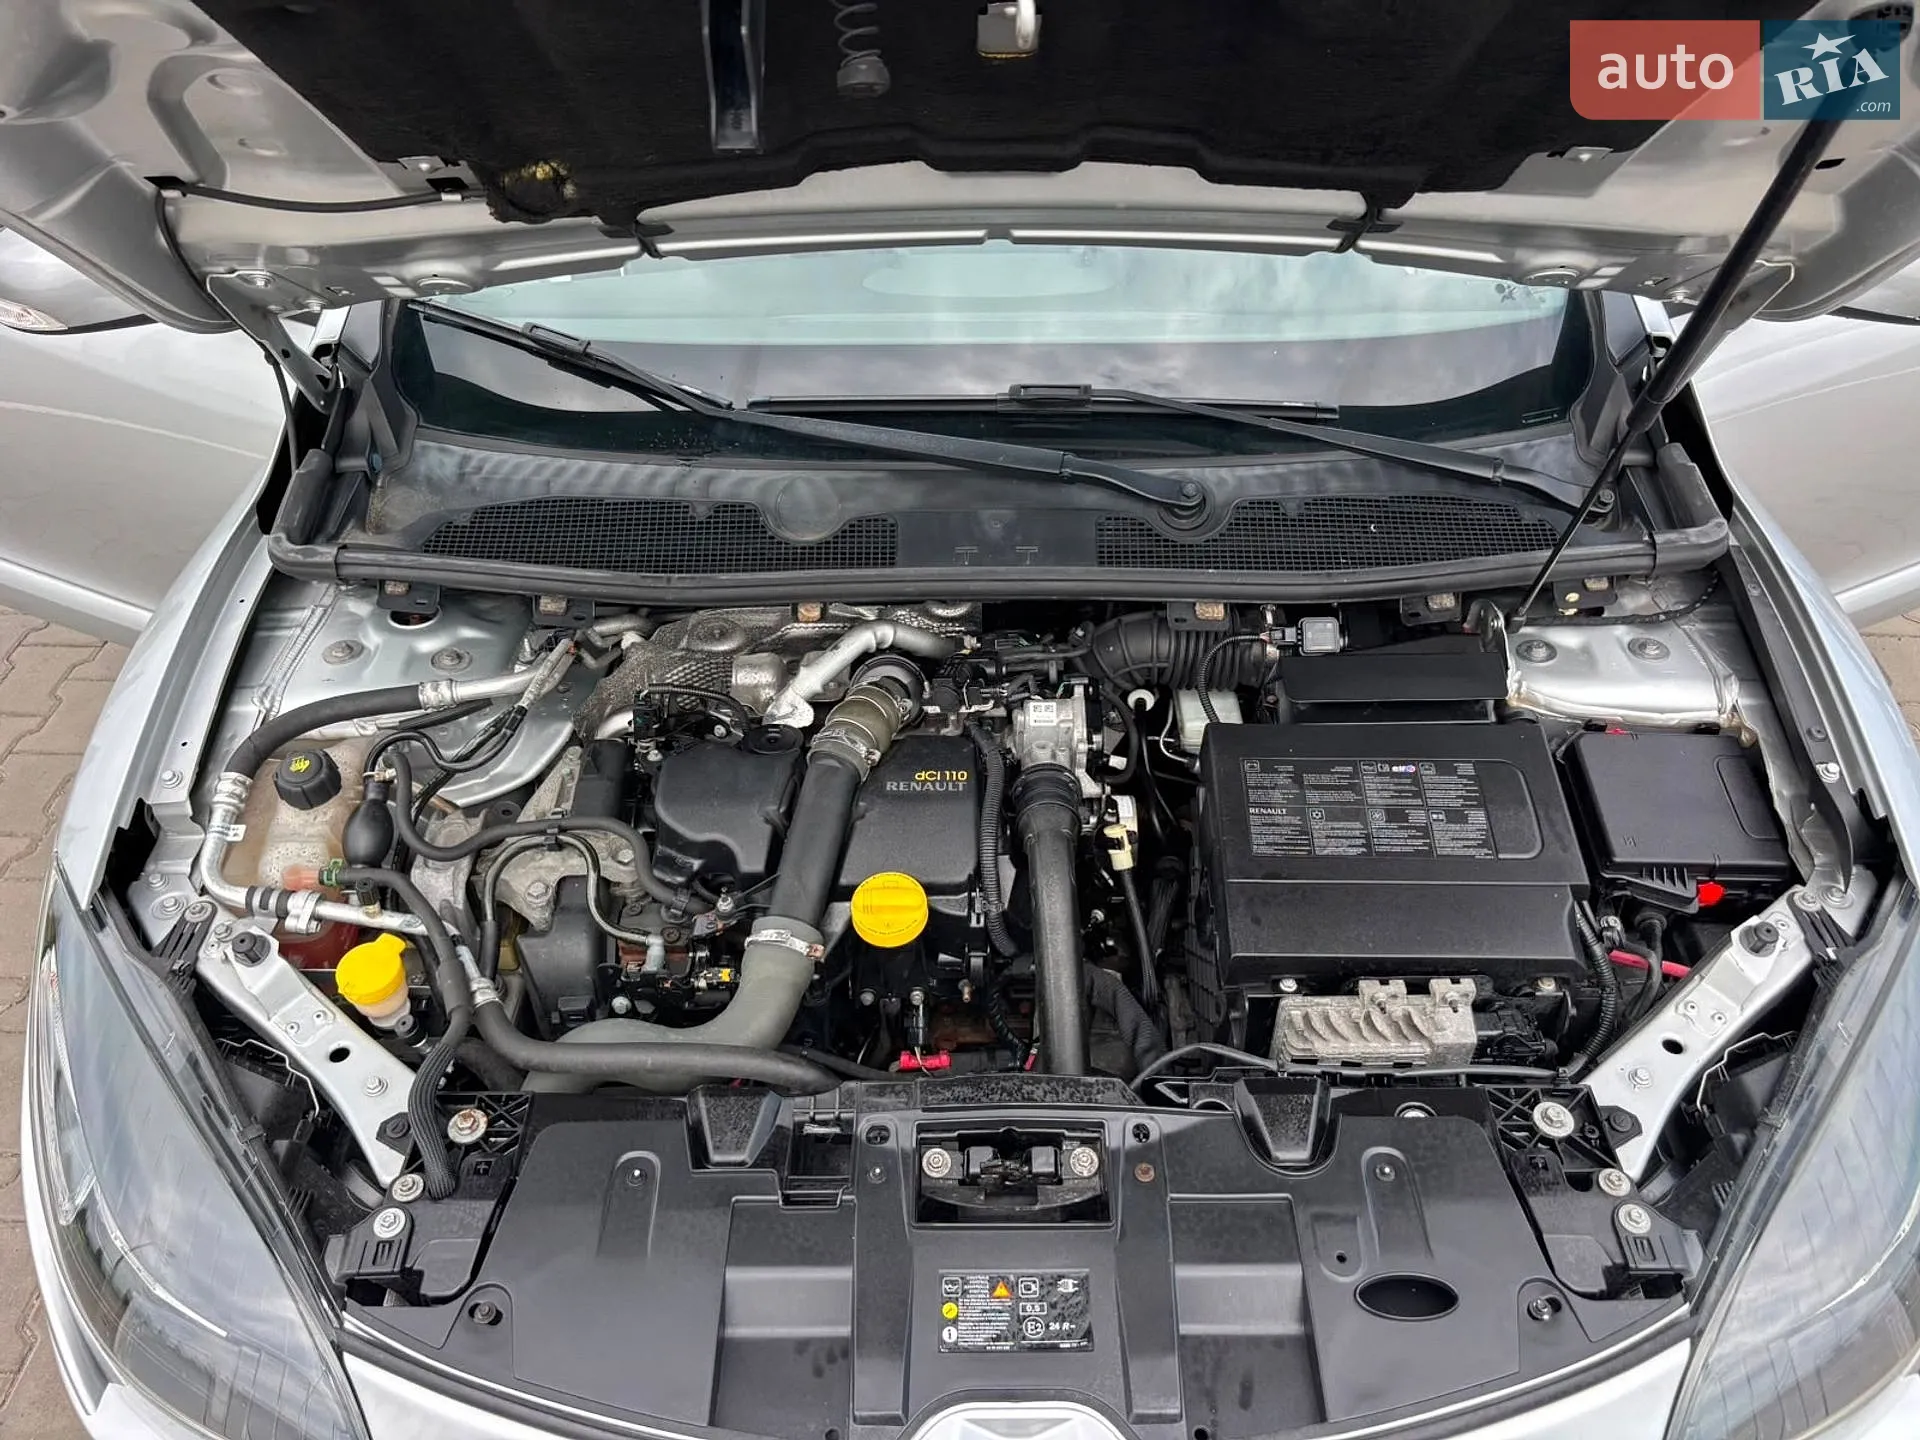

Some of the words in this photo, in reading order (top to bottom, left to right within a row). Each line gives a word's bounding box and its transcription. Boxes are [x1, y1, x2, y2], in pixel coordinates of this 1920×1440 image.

[944, 770, 968, 781] 110
[886, 781, 968, 792] RENAULT
[1249, 807, 1287, 815] RENAULT
[1027, 1321, 1042, 1334] E2
